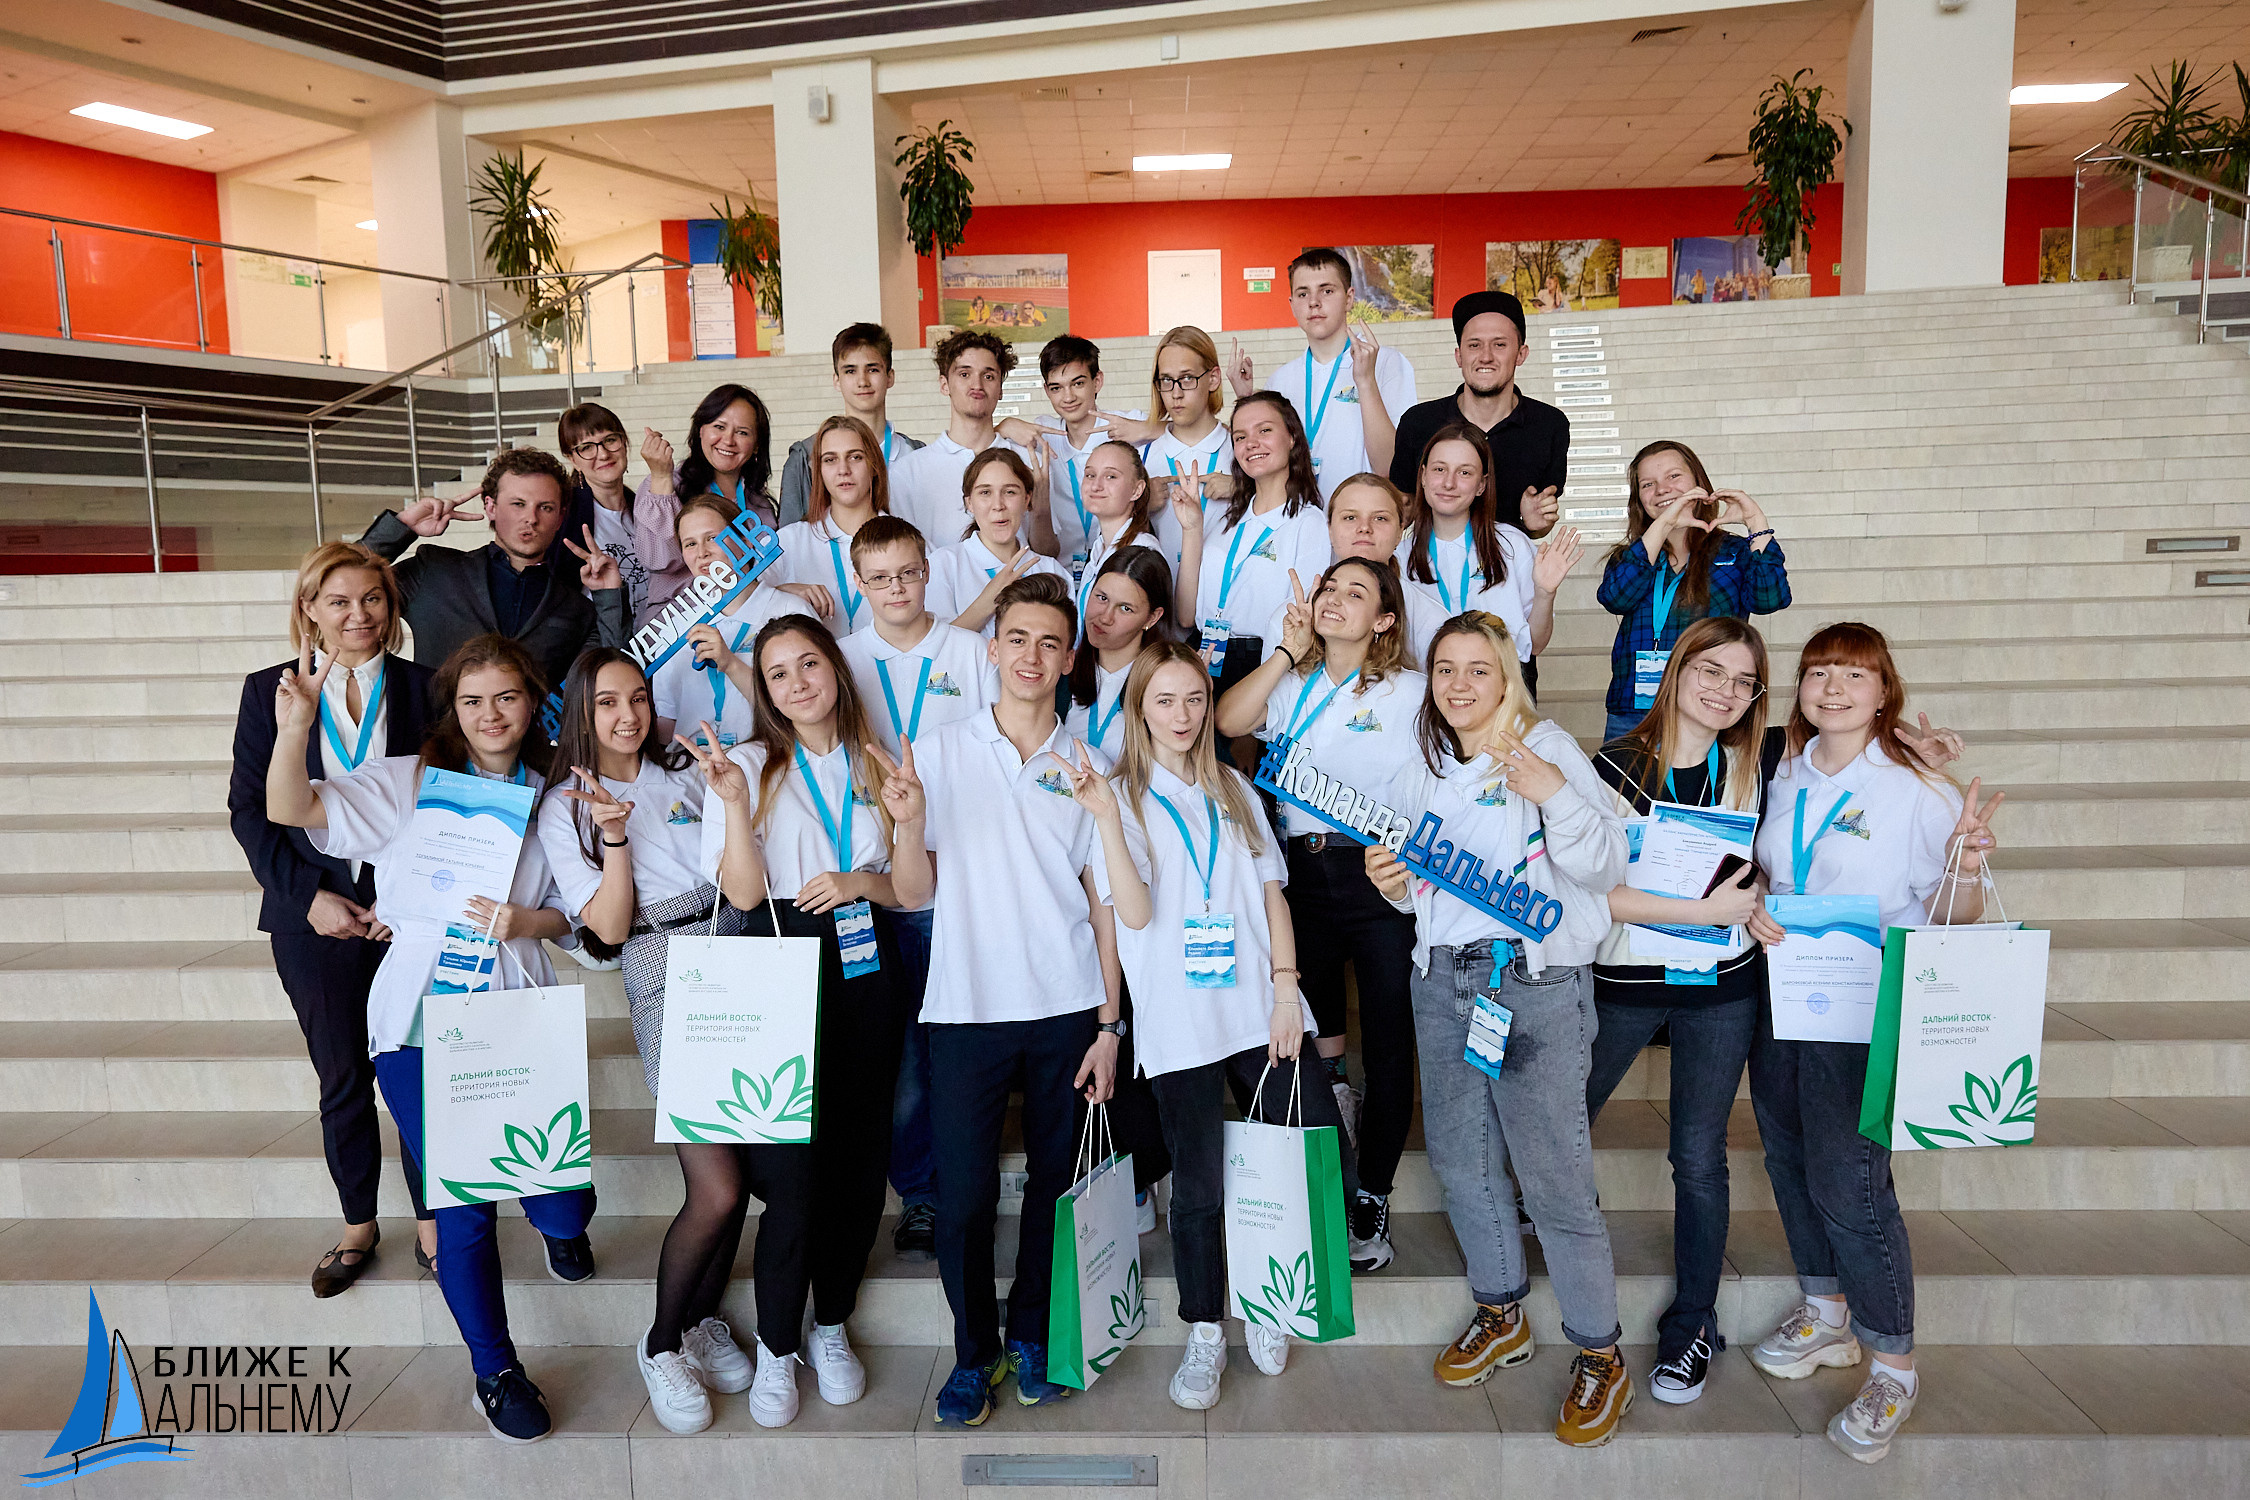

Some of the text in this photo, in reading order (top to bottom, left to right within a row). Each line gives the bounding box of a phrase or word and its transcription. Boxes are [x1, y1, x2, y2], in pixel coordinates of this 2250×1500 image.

[438, 830, 495, 846] ДИПЛОМ ПРИЗЕРА
[1259, 733, 1563, 936] #КомандаДальнего
[686, 1012, 762, 1022] ДАЛЬНИЙ ВОСТОК
[1922, 1013, 1992, 1024] ДАЛЬНИЙ ВОСТОК
[1922, 1025, 1990, 1035] ТЕРРИТОРИЯ НОВЫХ
[685, 1035, 746, 1043] ВОЗМОЖНОСТЕЙ
[1921, 1037, 1977, 1046] ВОЗМОЖНОСТЕЙ
[450, 1066, 531, 1082] ДАЛЬНИЙ ВОСТОК
[451, 1079, 530, 1092] ТЕРРИТОРИЯ НОВЫХ
[451, 1090, 516, 1103] ВОЗМОЖНОСТЕЙ
[1237, 1197, 1284, 1211] ДАЛЬНИЙ ВОСТОК
[1237, 1208, 1284, 1222] ТЕРРИТОРИЯ НОВЫХ
[1237, 1218, 1276, 1231] ВОЗМОЖНОСТЕЙ
